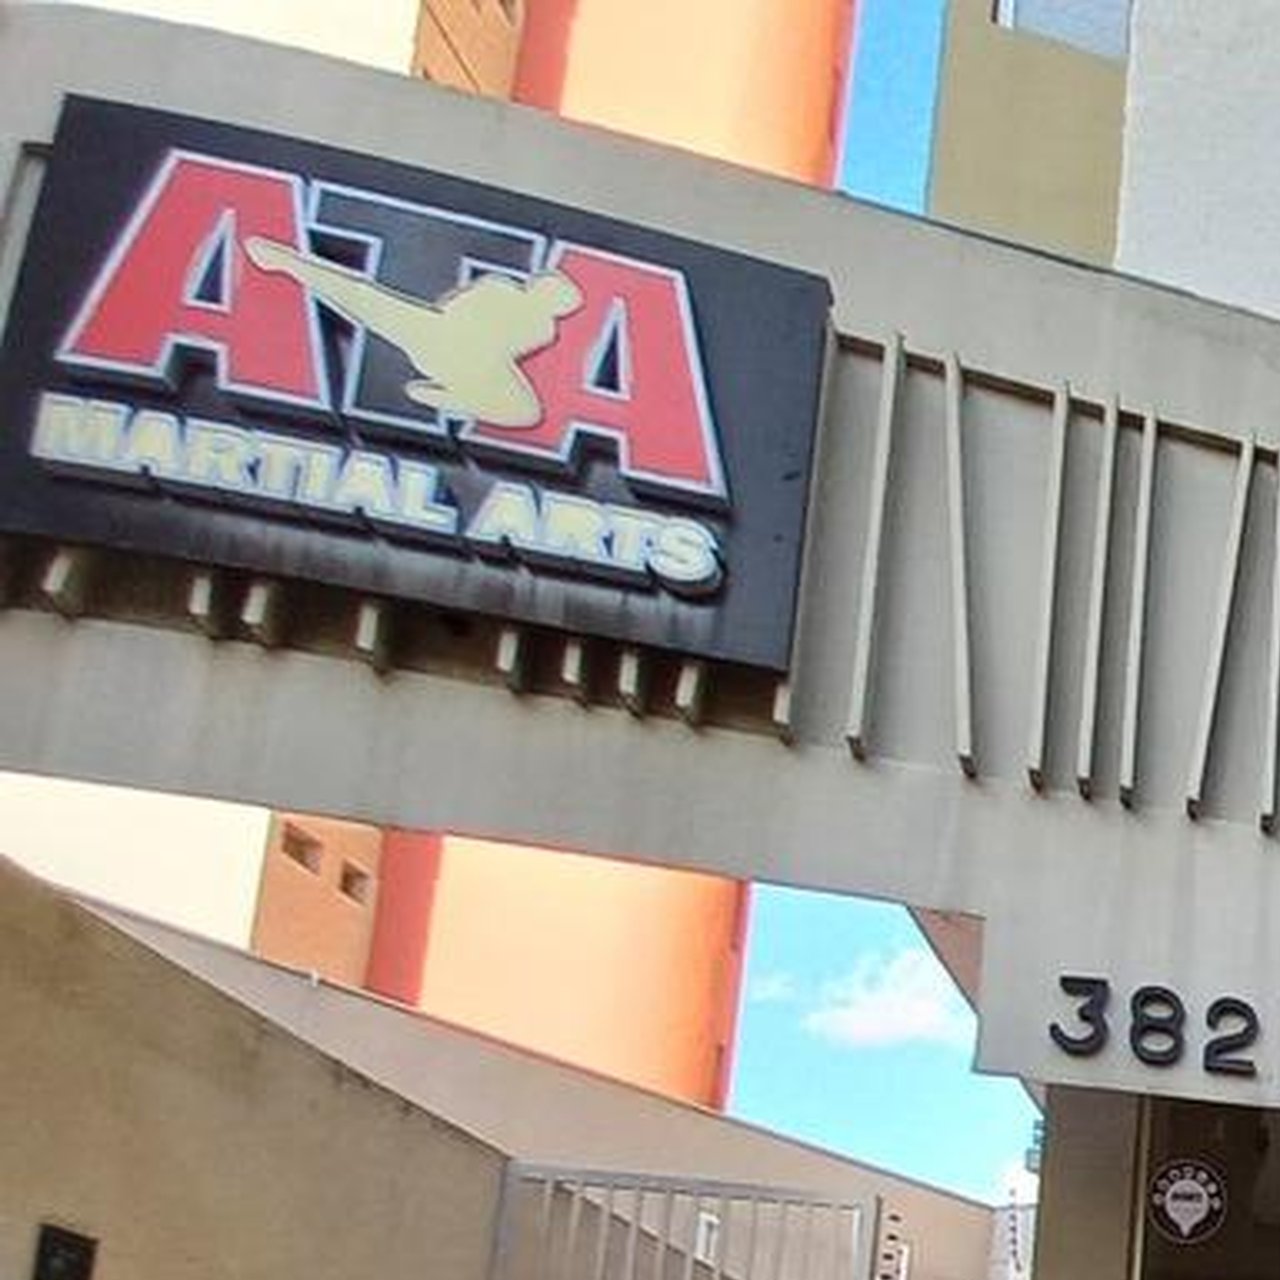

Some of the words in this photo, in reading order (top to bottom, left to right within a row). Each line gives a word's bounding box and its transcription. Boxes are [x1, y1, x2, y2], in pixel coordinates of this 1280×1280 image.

[54, 149, 727, 499] ATA
[29, 392, 463, 533] MARTIAL
[464, 481, 722, 588] ARTS
[1049, 975, 1260, 1077] 382
